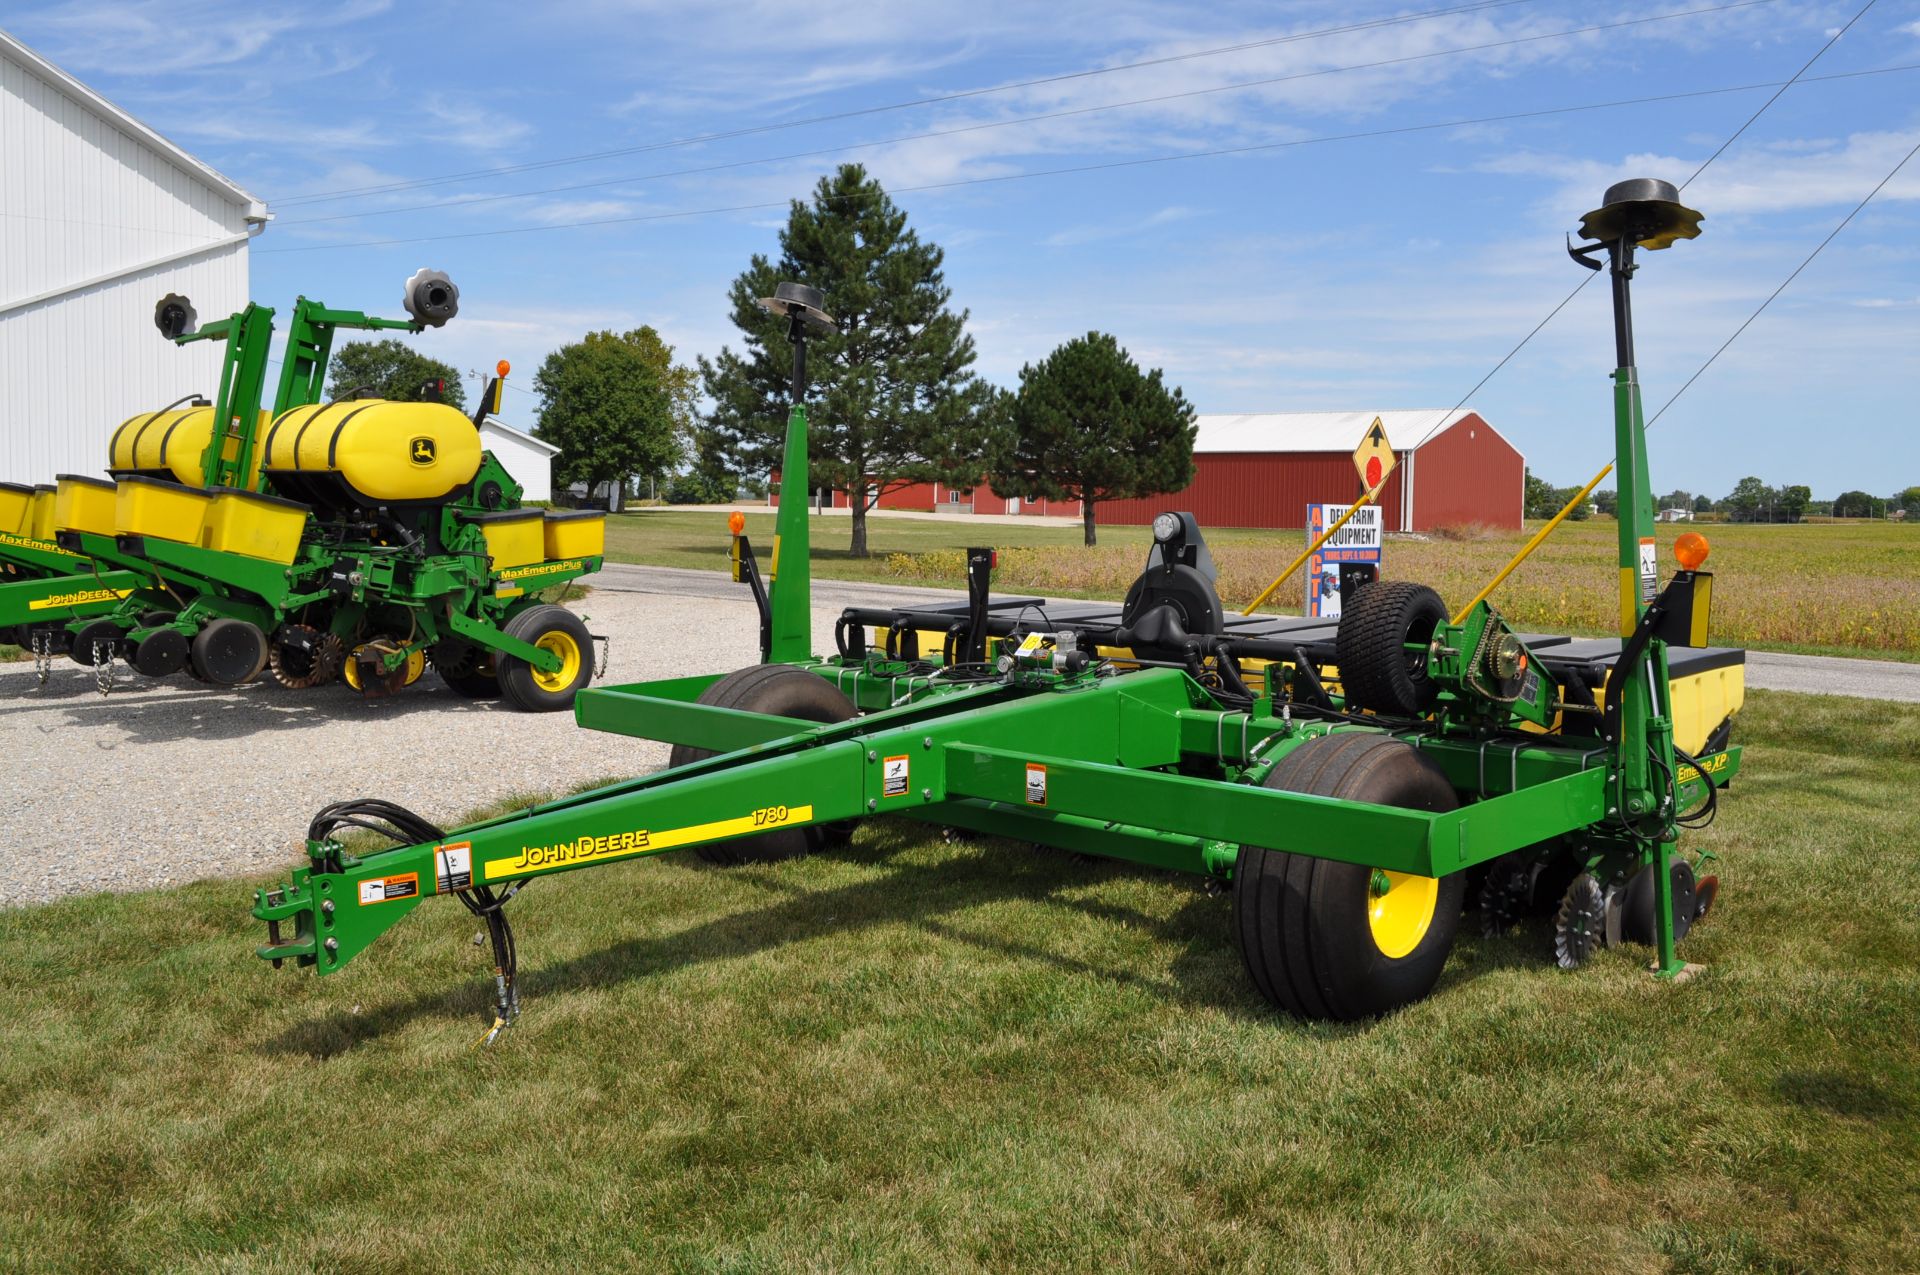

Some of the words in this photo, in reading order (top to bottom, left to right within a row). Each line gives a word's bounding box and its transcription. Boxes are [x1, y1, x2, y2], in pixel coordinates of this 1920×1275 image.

[46, 593, 78, 606] JOHN
[1711, 753, 1728, 773] XP
[751, 805, 789, 826] 1780
[514, 846, 575, 868] JOHN
[576, 828, 650, 857] DEERE
